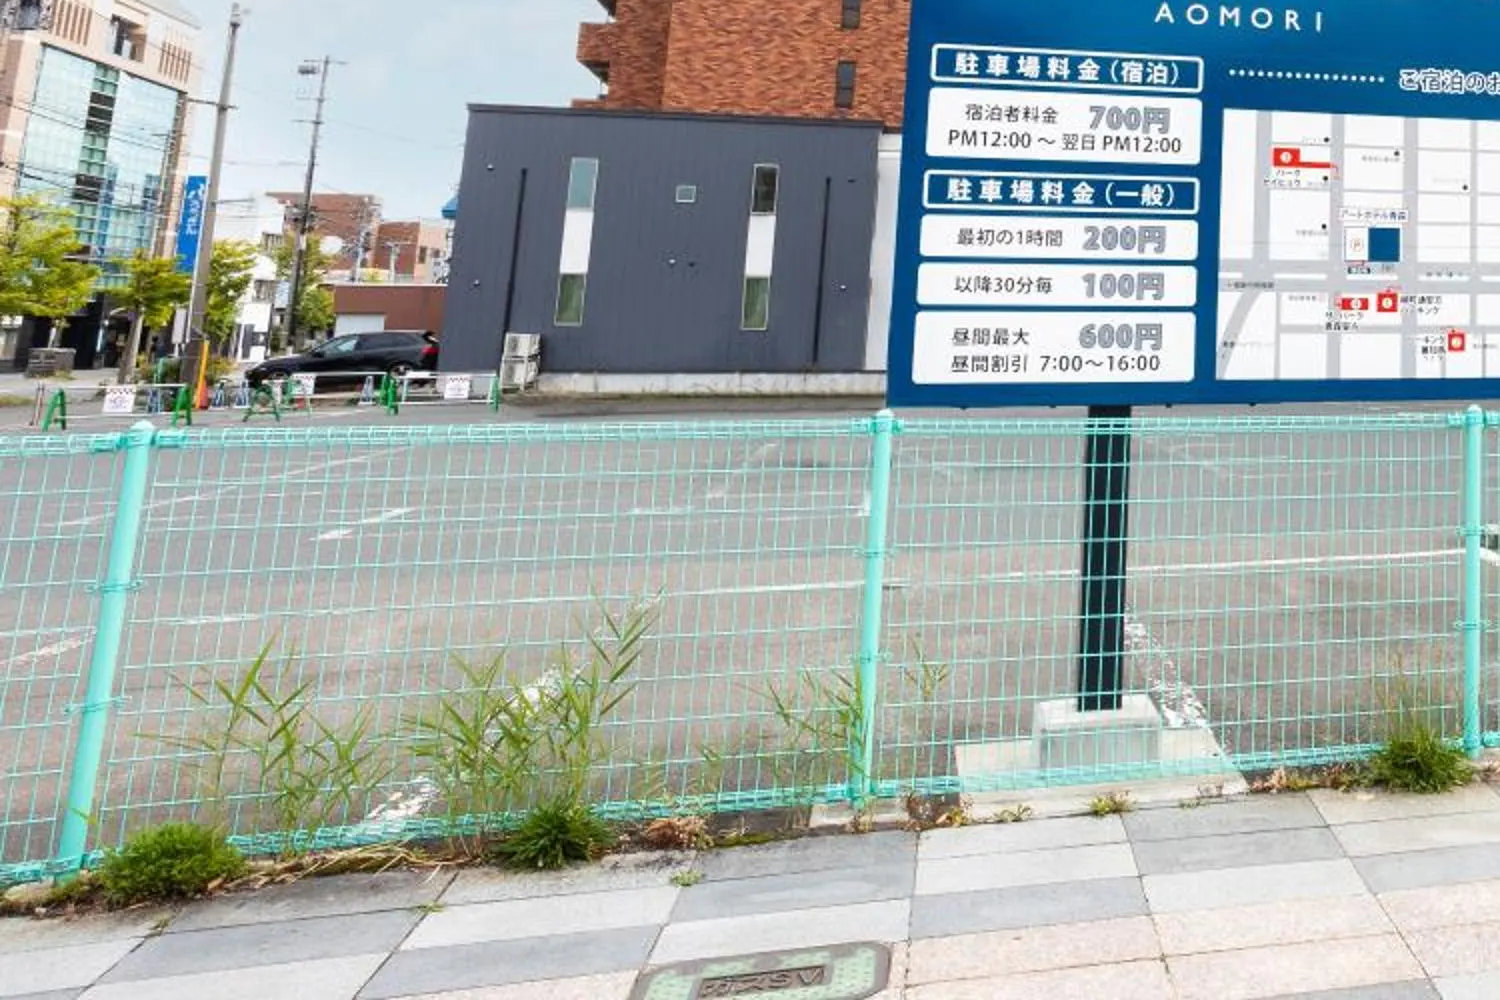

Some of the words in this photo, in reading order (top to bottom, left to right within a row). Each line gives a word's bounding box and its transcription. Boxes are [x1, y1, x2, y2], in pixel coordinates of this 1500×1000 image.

[1154, 2, 1324, 34] AOMORI
[965, 104, 1059, 126] 宿泊者料金
[1089, 105, 1171, 135] 700円
[948, 130, 1032, 149] PM12:00
[1062, 134, 1096, 152] 翌日
[1102, 136, 1182, 154] PM12:00
[956, 228, 1063, 248] 最初の1時間
[1082, 226, 1167, 254] 200円
[953, 276, 1053, 295] 以降30分毎
[1082, 272, 1165, 301] 100円
[951, 327, 1030, 347] 昼間最大
[1078, 322, 1163, 352] 600円
[951, 355, 1029, 374] 昼間割引
